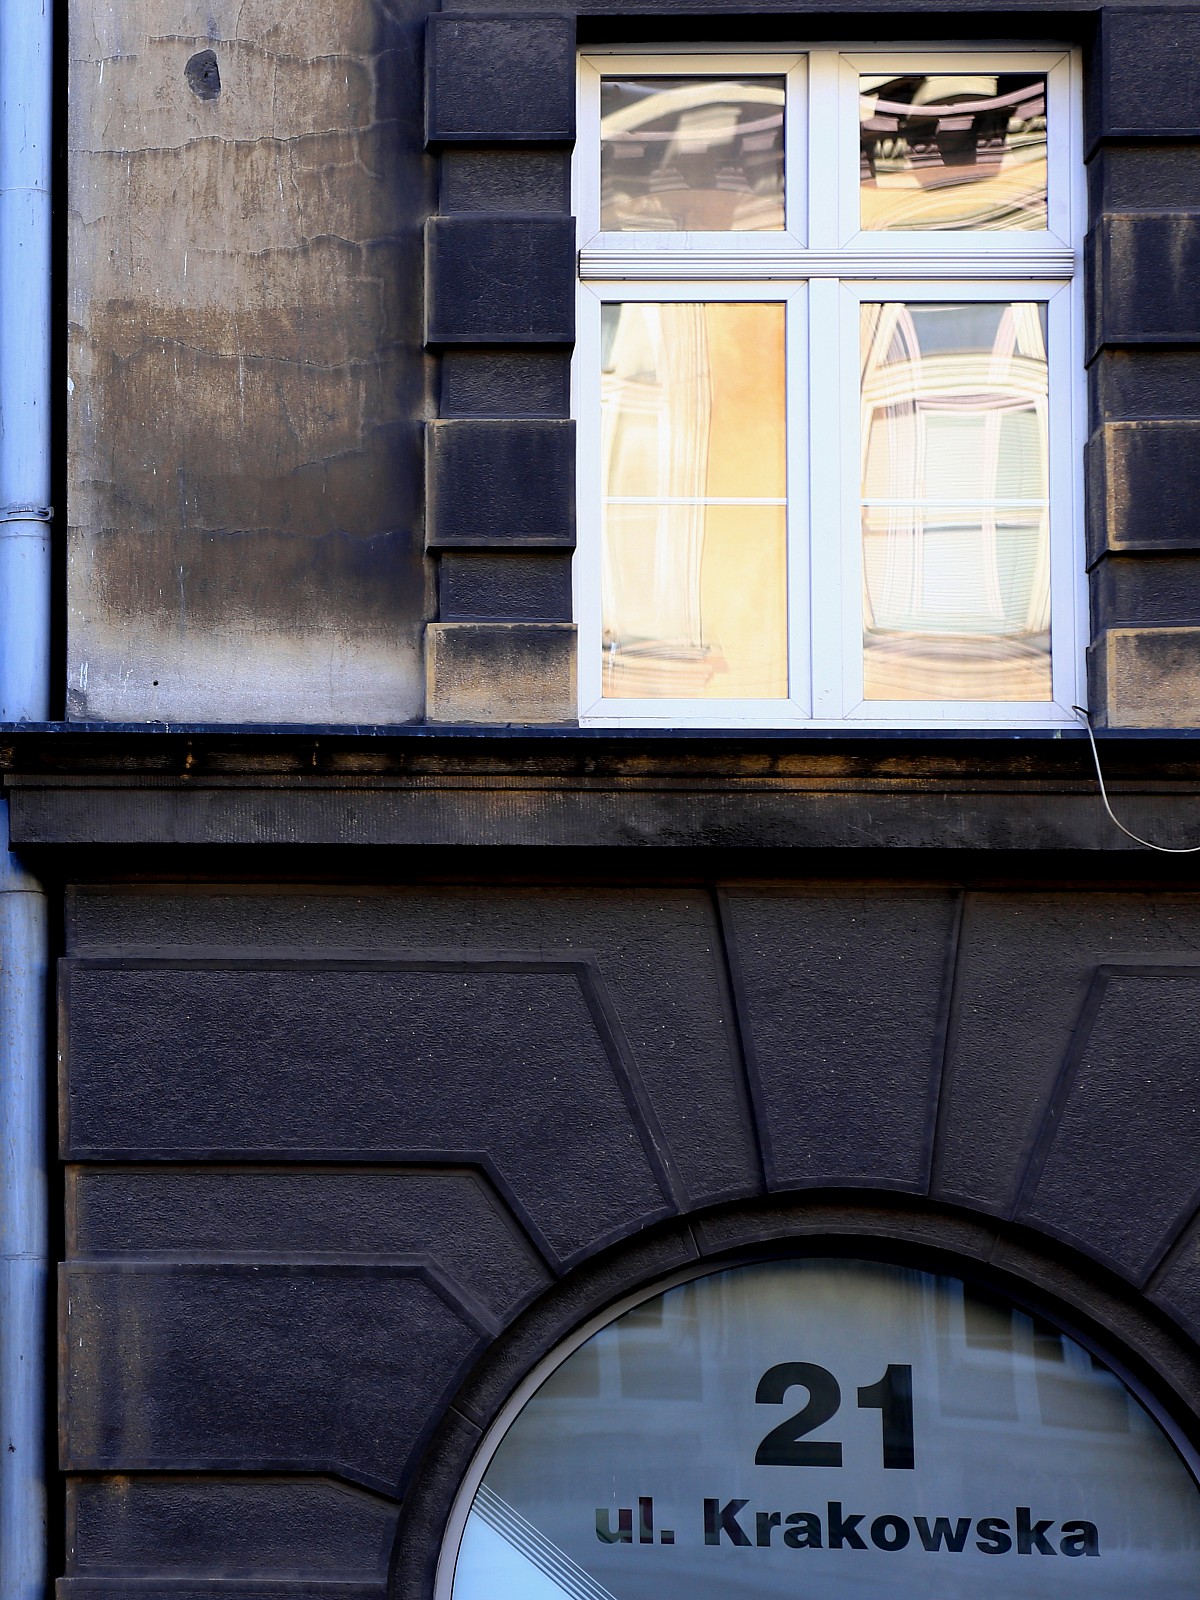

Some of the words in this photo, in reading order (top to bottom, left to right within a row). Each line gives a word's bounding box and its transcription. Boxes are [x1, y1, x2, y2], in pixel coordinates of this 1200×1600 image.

[754, 1361, 915, 1470] 21
[595, 1496, 675, 1545] ul.
[703, 1497, 1101, 1558] Krakowska
